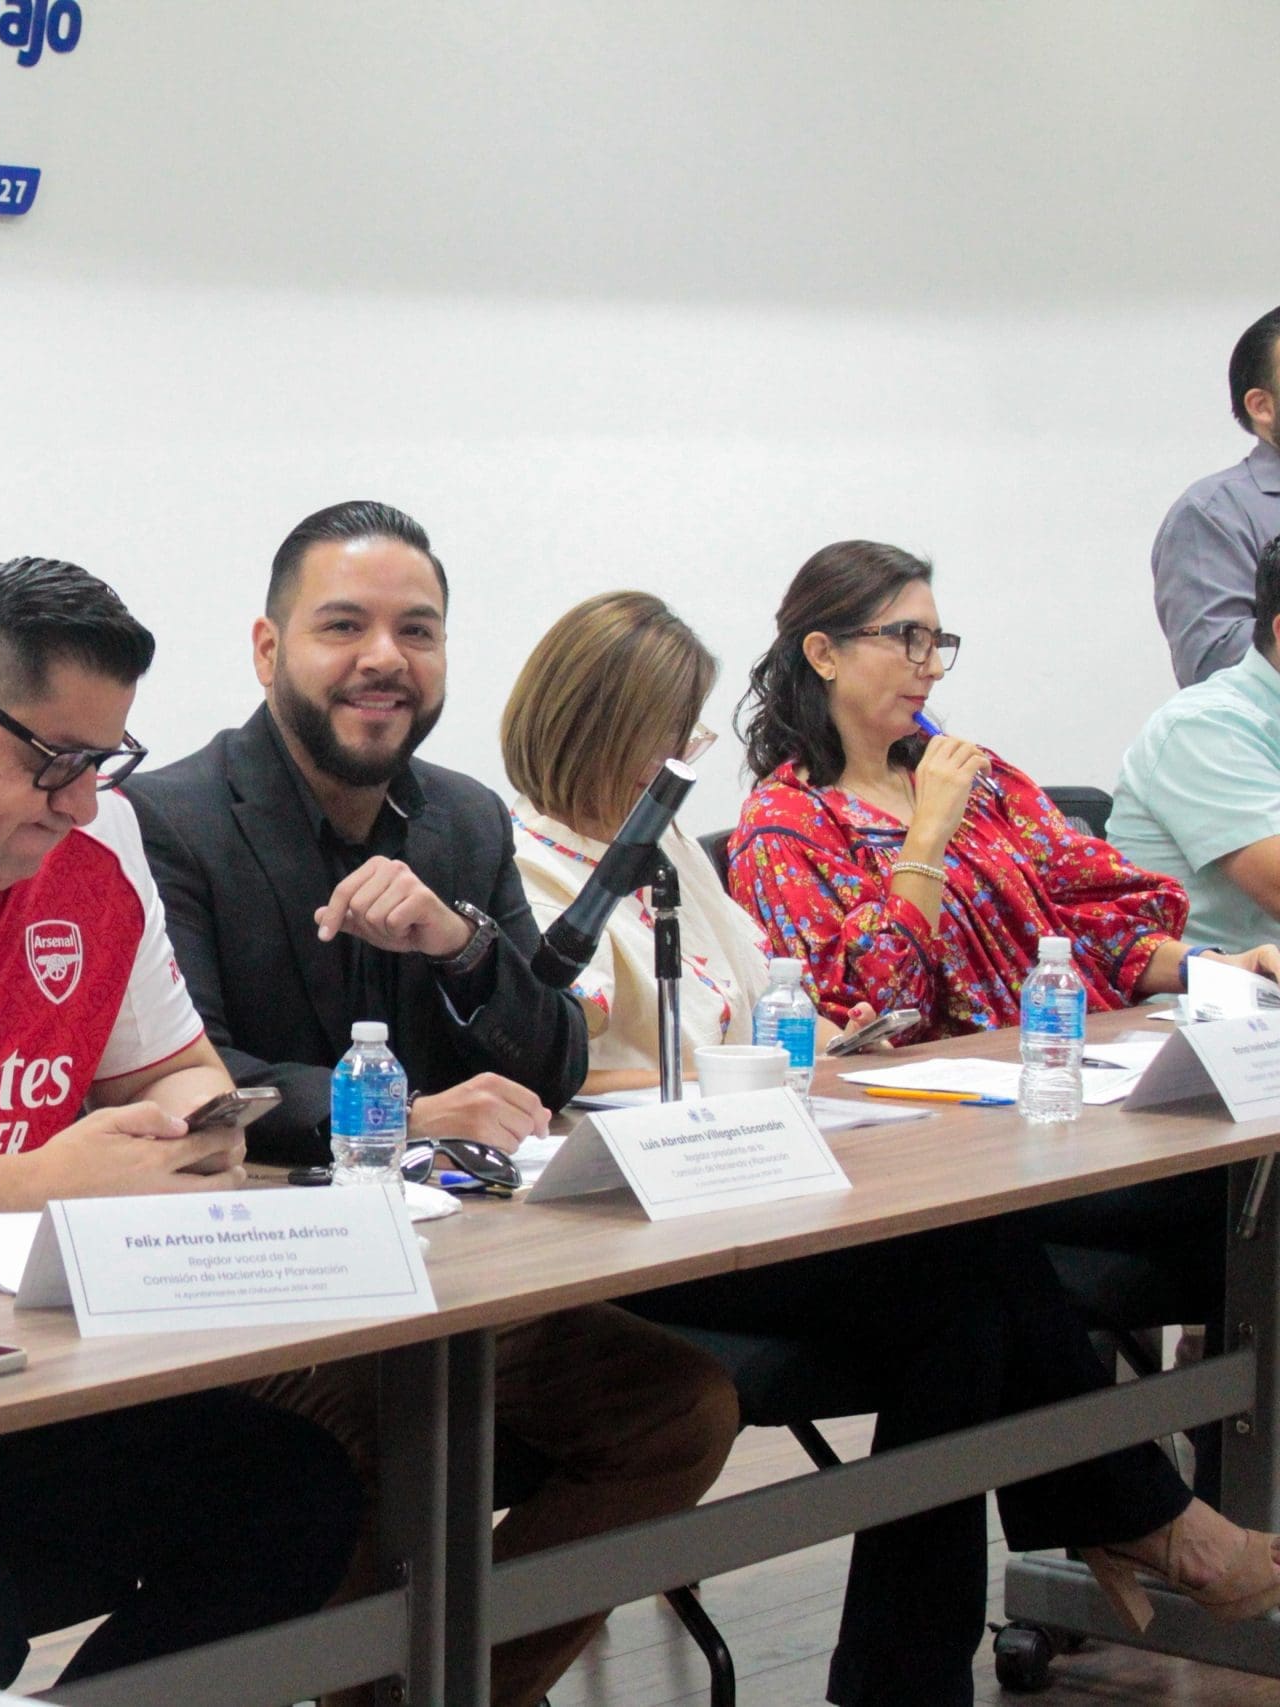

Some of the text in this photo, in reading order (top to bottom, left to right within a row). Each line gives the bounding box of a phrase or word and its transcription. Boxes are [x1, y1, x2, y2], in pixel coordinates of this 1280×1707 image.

[34, 934, 74, 949] Arsenal
[639, 1138, 661, 1151] Luis
[661, 1133, 705, 1147] Abraham
[704, 1128, 741, 1141] Villegas
[125, 1235, 161, 1249] Felix
[165, 1232, 214, 1246] Arturo
[289, 1225, 349, 1240] Adriano
